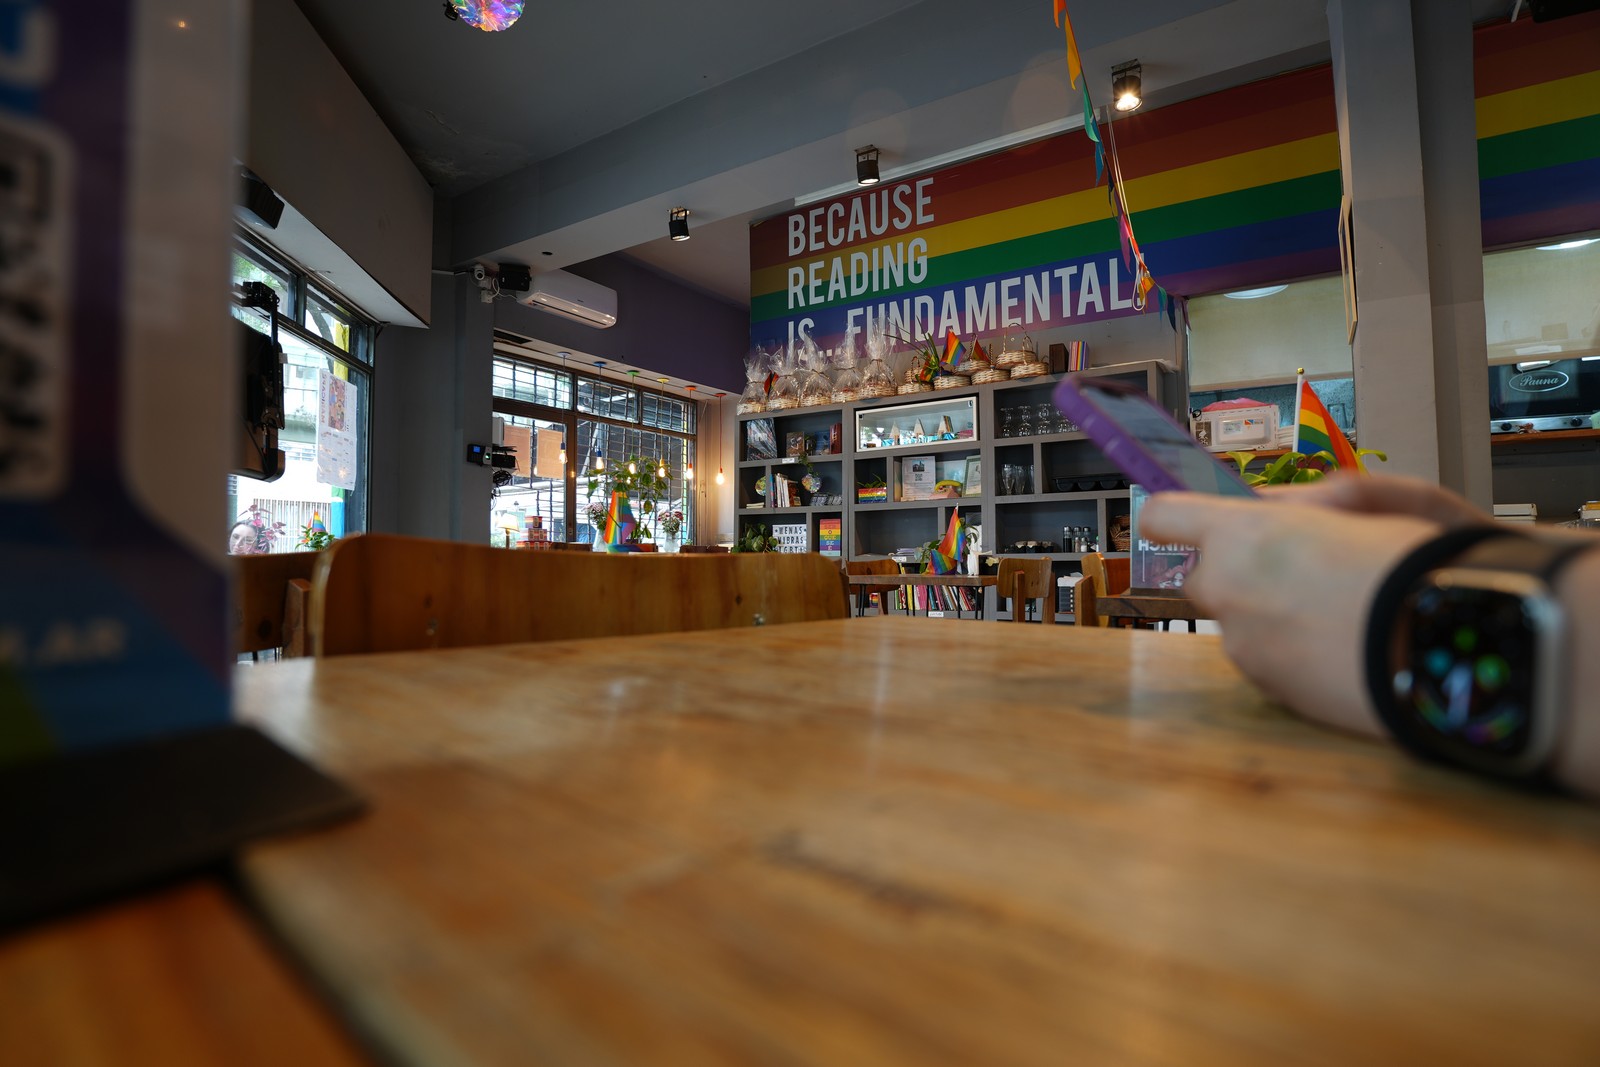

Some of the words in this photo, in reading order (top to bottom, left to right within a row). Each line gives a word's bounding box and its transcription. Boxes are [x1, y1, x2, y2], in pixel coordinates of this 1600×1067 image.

[788, 177, 935, 257] BECAUSE
[788, 237, 928, 310] READING
[1520, 375, 1559, 387] Pauna
[779, 526, 803, 535] WENAS
[778, 536, 804, 544] VIBRAS
